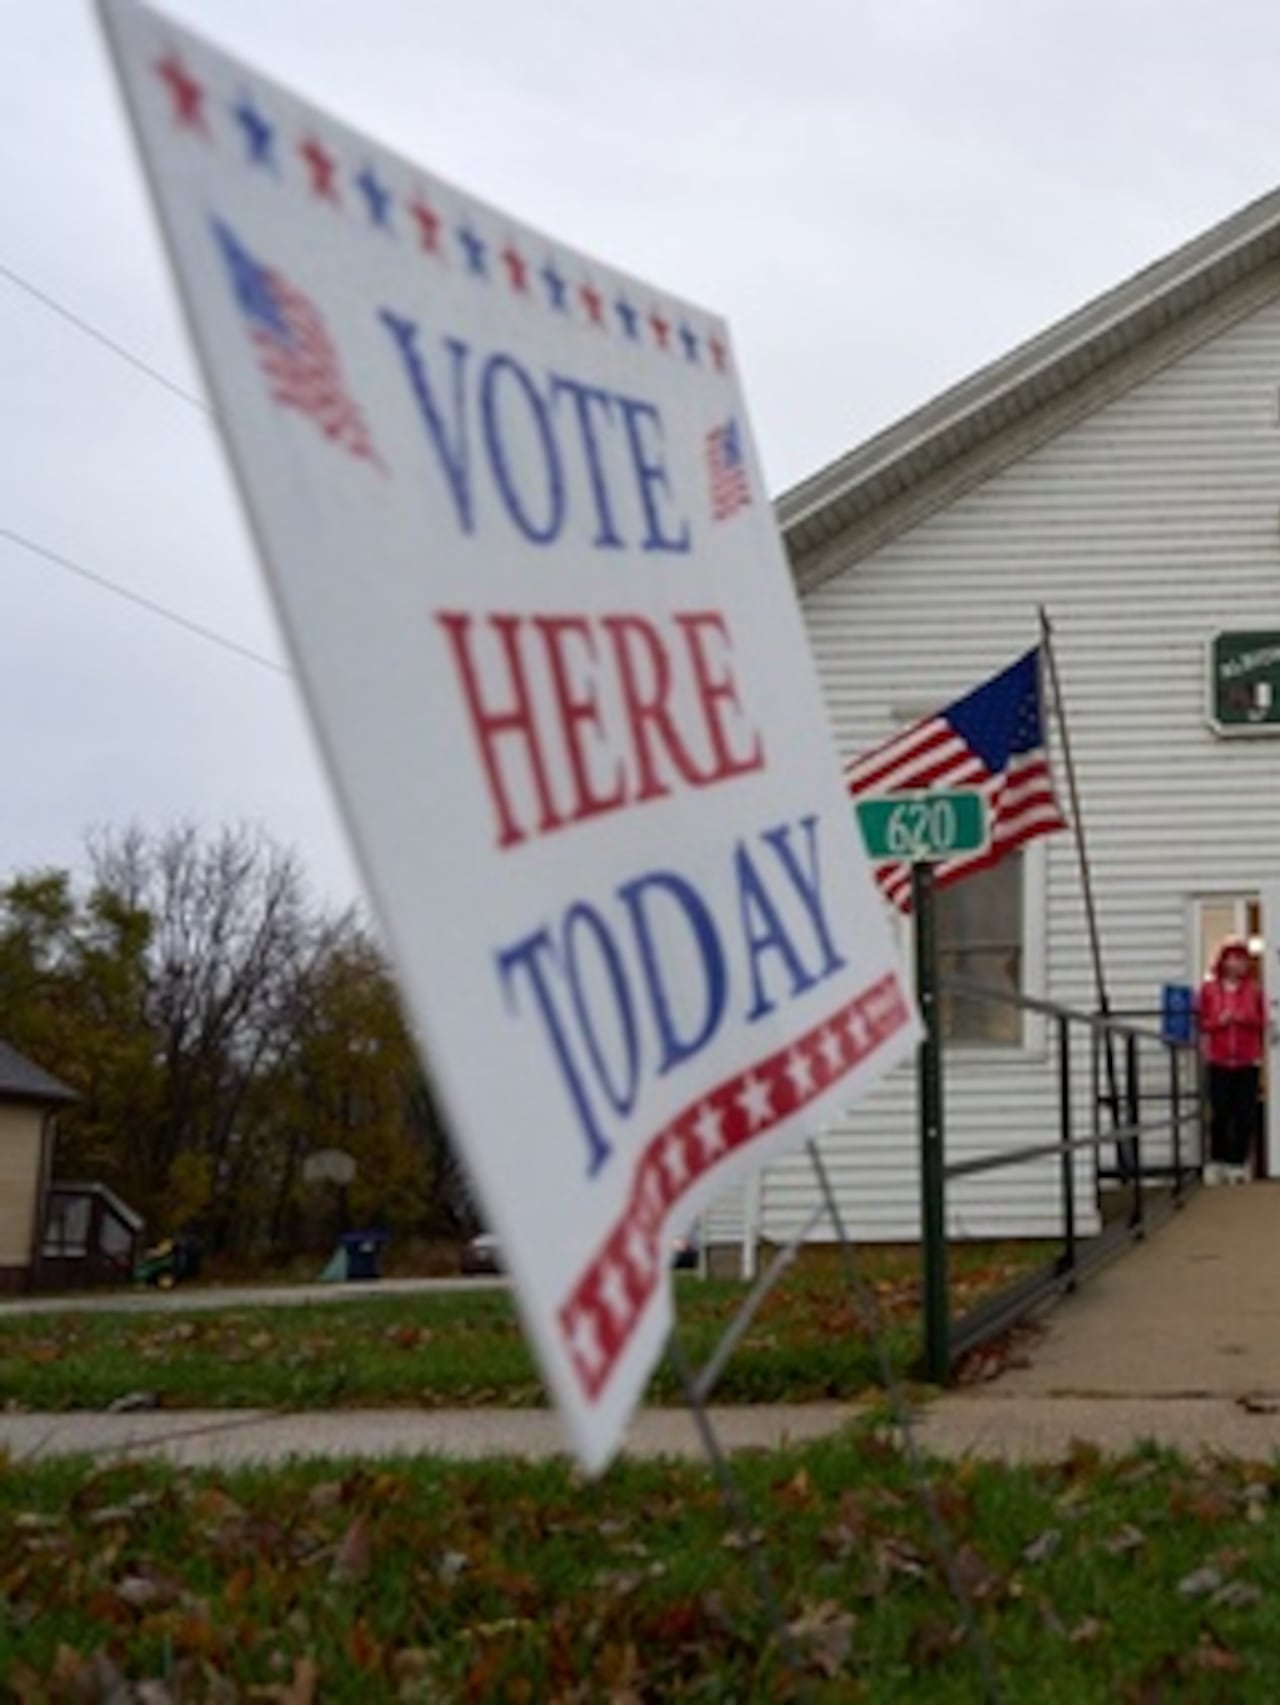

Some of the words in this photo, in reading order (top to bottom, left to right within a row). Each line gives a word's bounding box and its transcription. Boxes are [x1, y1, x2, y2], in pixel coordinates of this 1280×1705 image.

[378, 306, 692, 553] VOTE
[433, 610, 766, 851] HERE
[886, 799, 957, 855] 620
[493, 815, 848, 1180] TODAY
